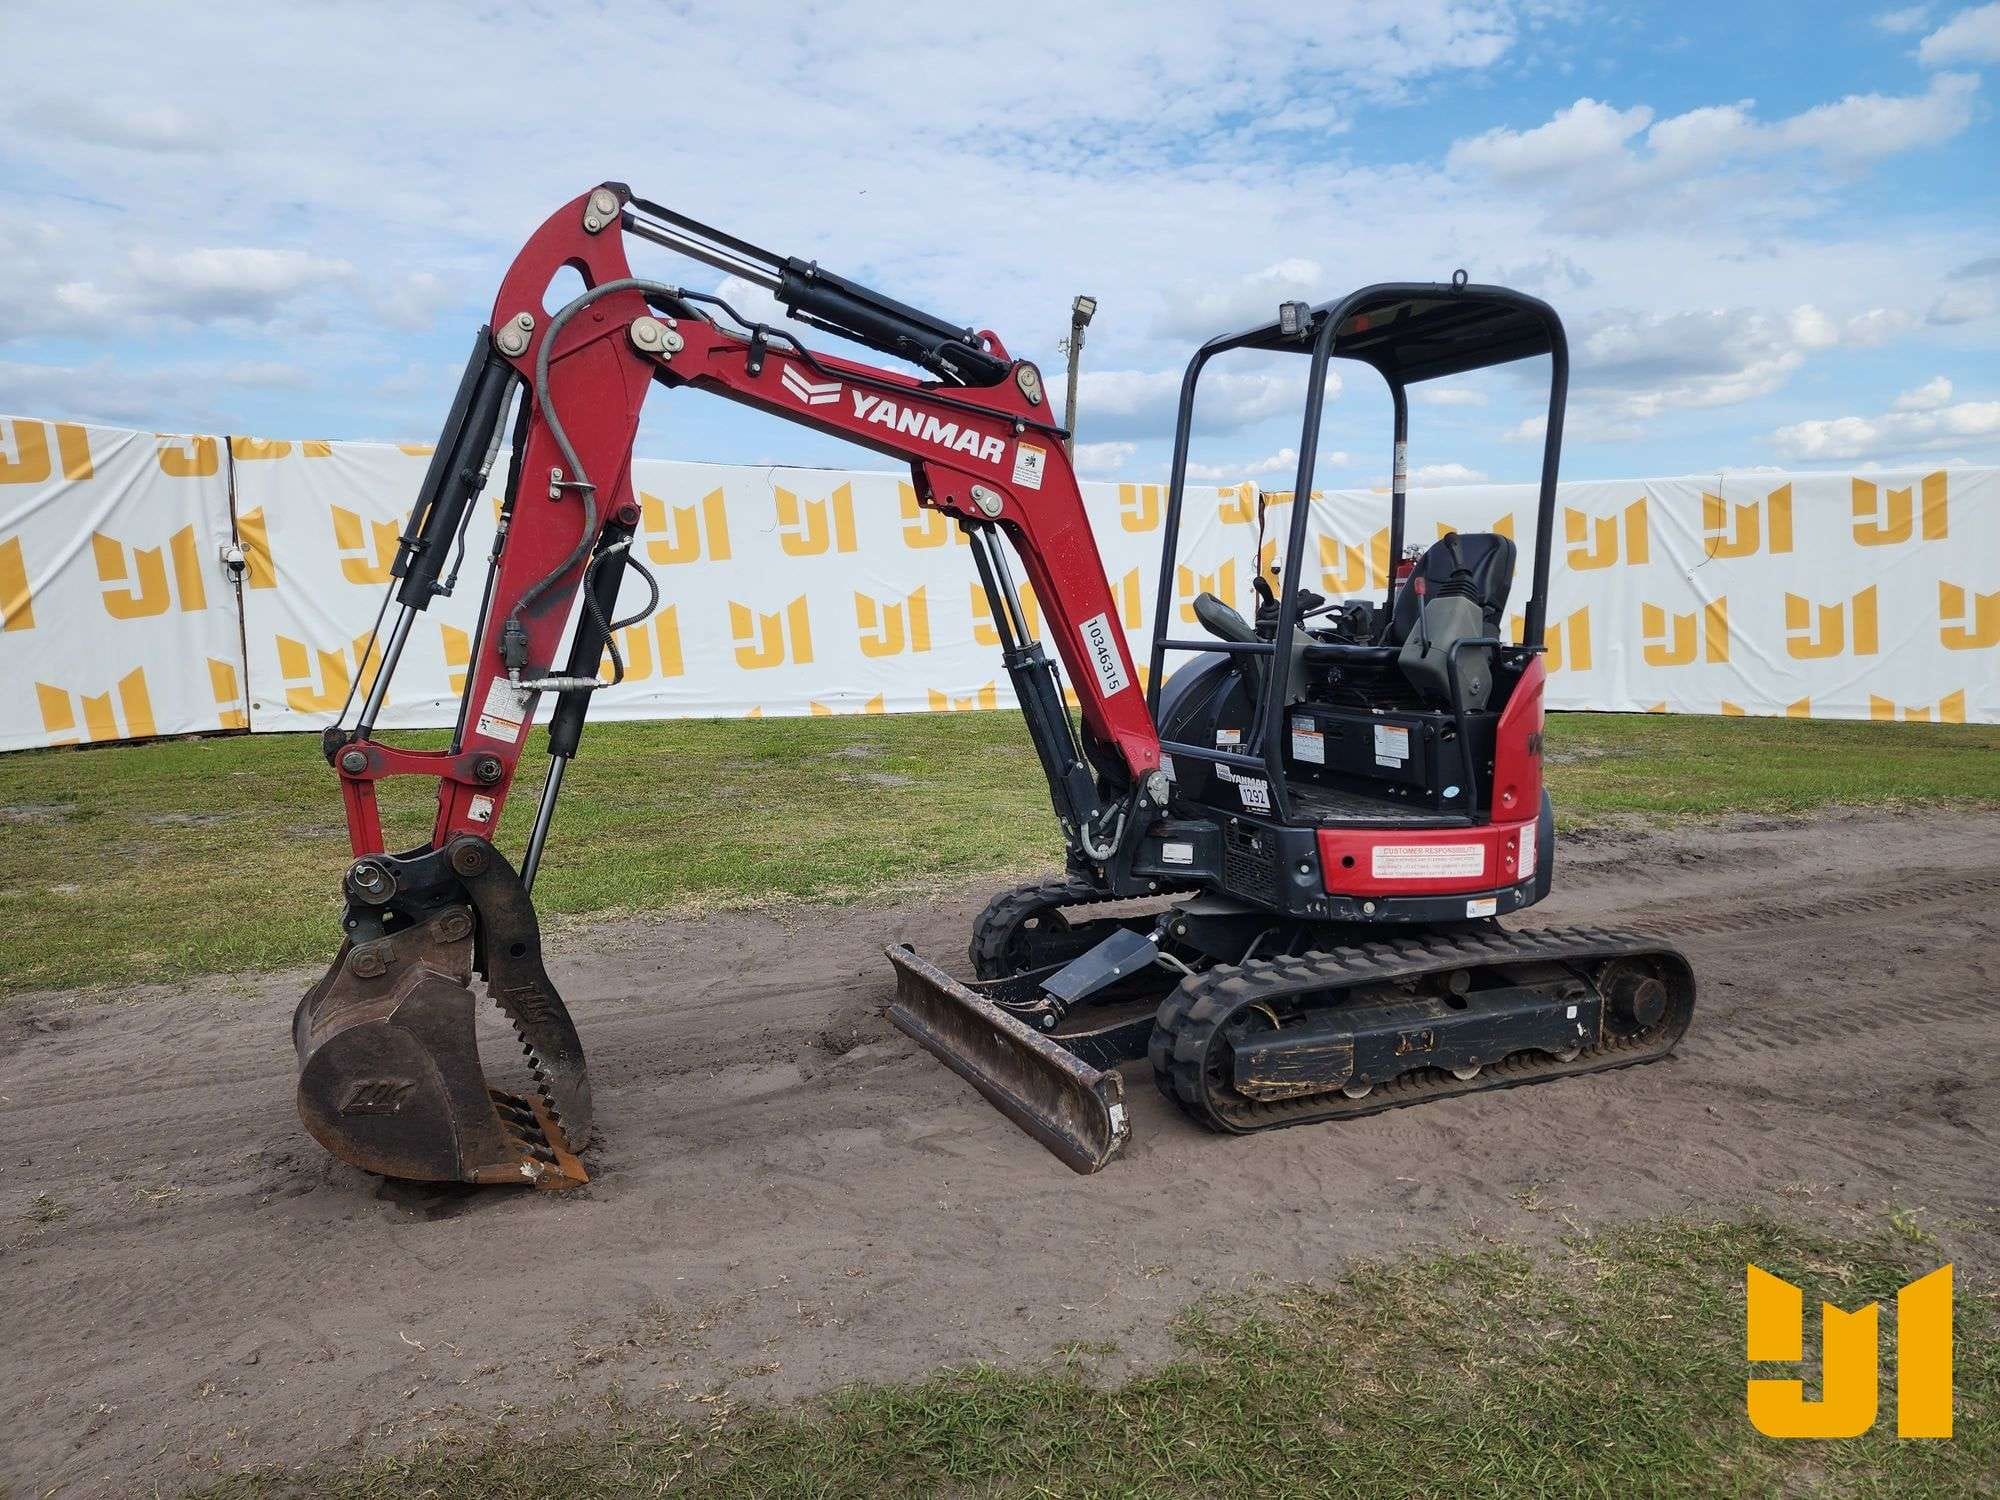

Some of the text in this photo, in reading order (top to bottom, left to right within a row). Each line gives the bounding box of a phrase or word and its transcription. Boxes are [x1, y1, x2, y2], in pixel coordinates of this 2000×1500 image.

[851, 389, 1006, 464] YANMAR
[1087, 619, 1120, 690] 10346315
[1243, 788, 1266, 804] 1292
